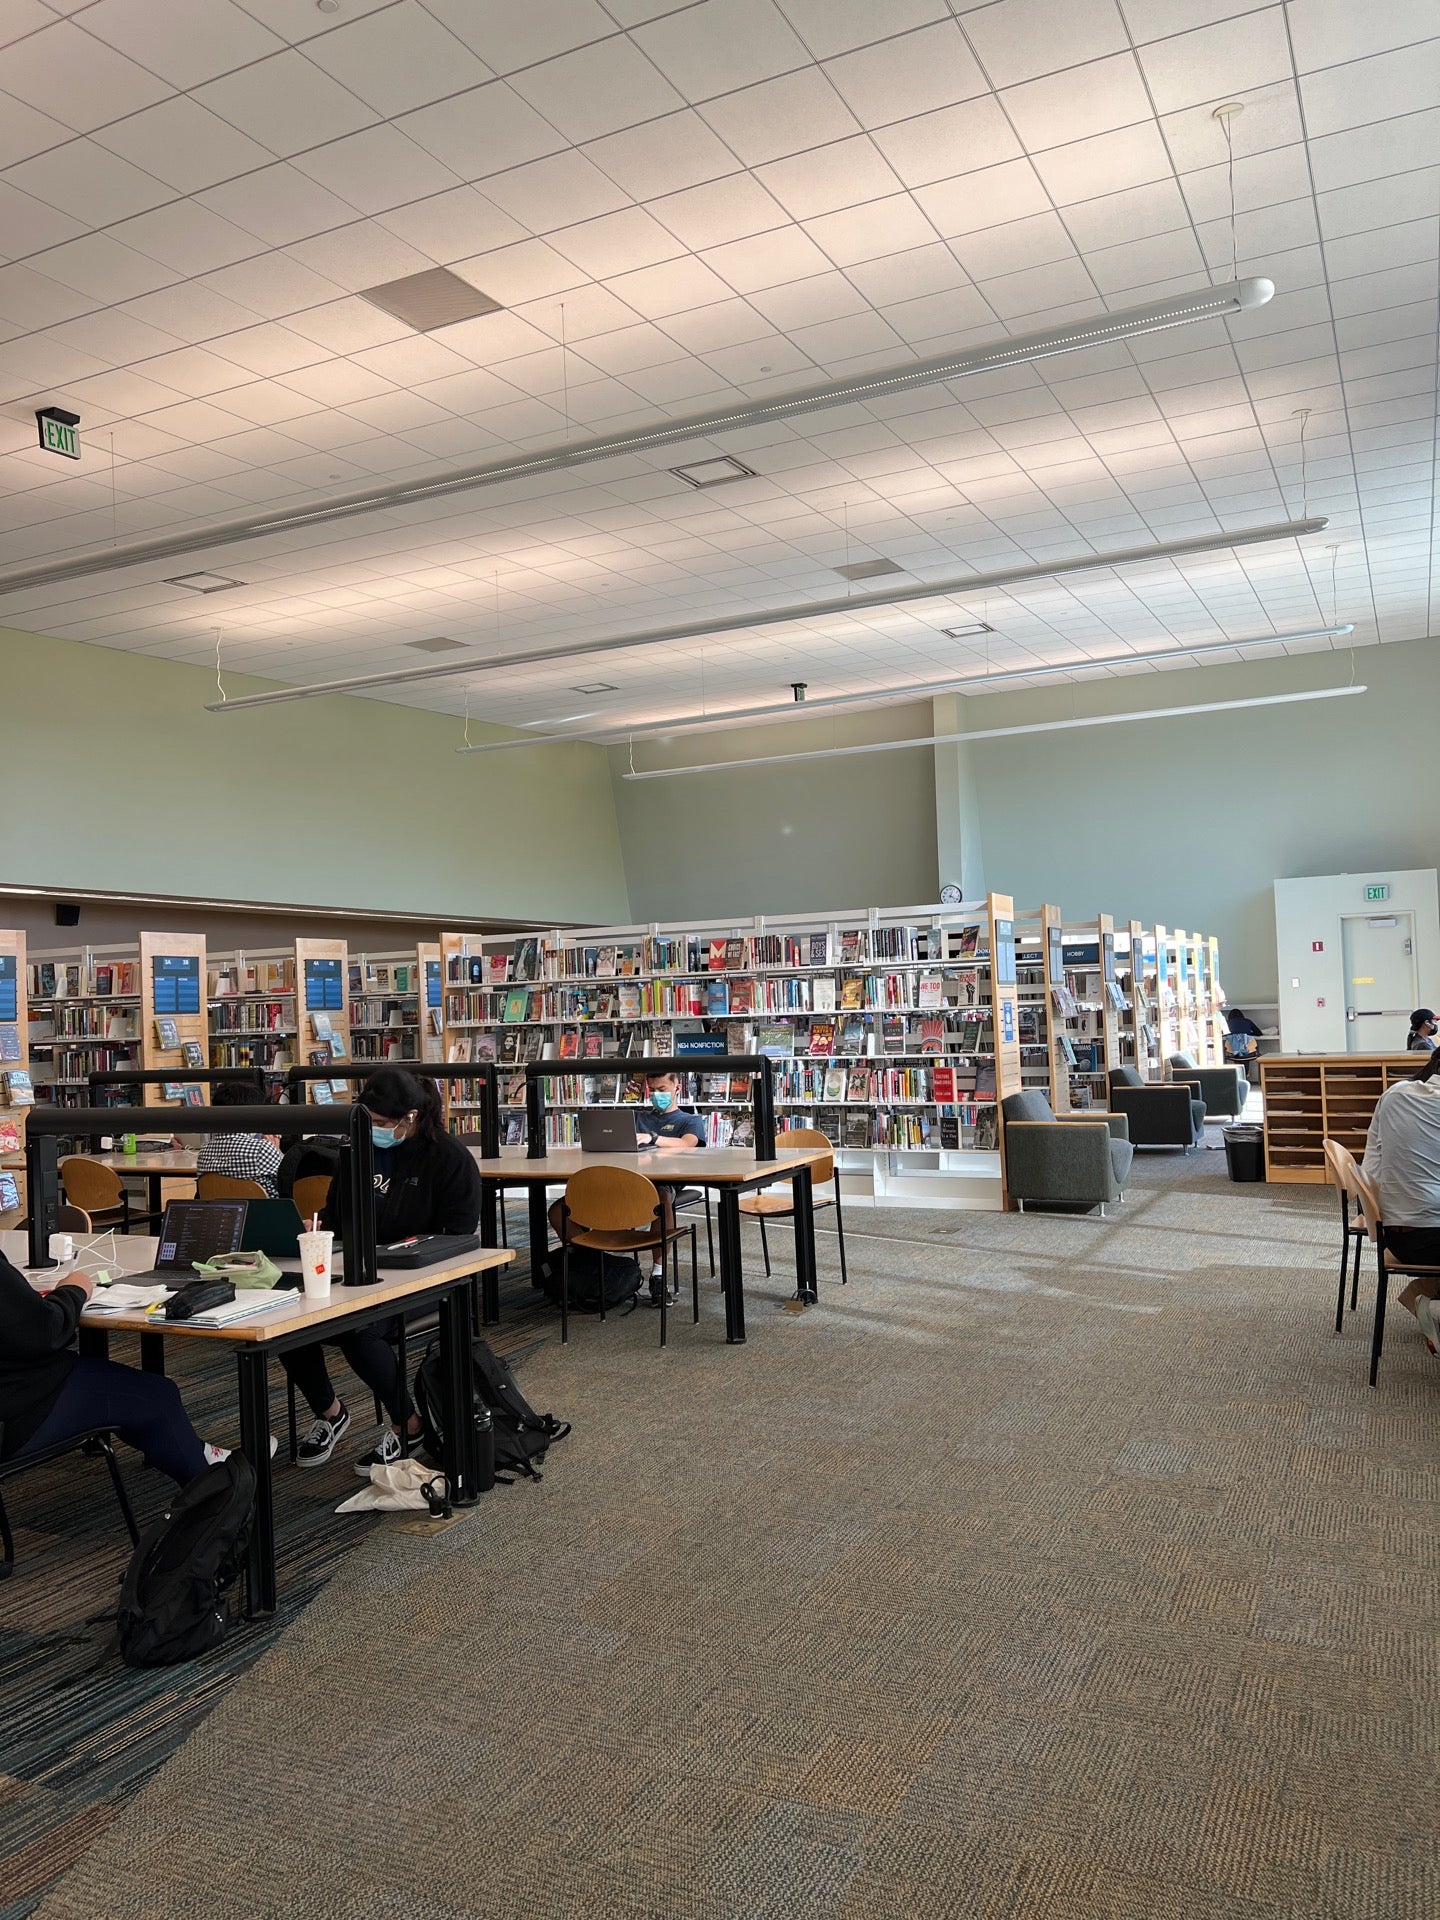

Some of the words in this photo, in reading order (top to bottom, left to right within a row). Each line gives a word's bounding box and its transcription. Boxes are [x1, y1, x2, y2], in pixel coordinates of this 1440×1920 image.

[46, 420, 76, 454] EXIT
[1367, 886, 1386, 900] EXIT
[811, 941, 826, 950] BOYS
